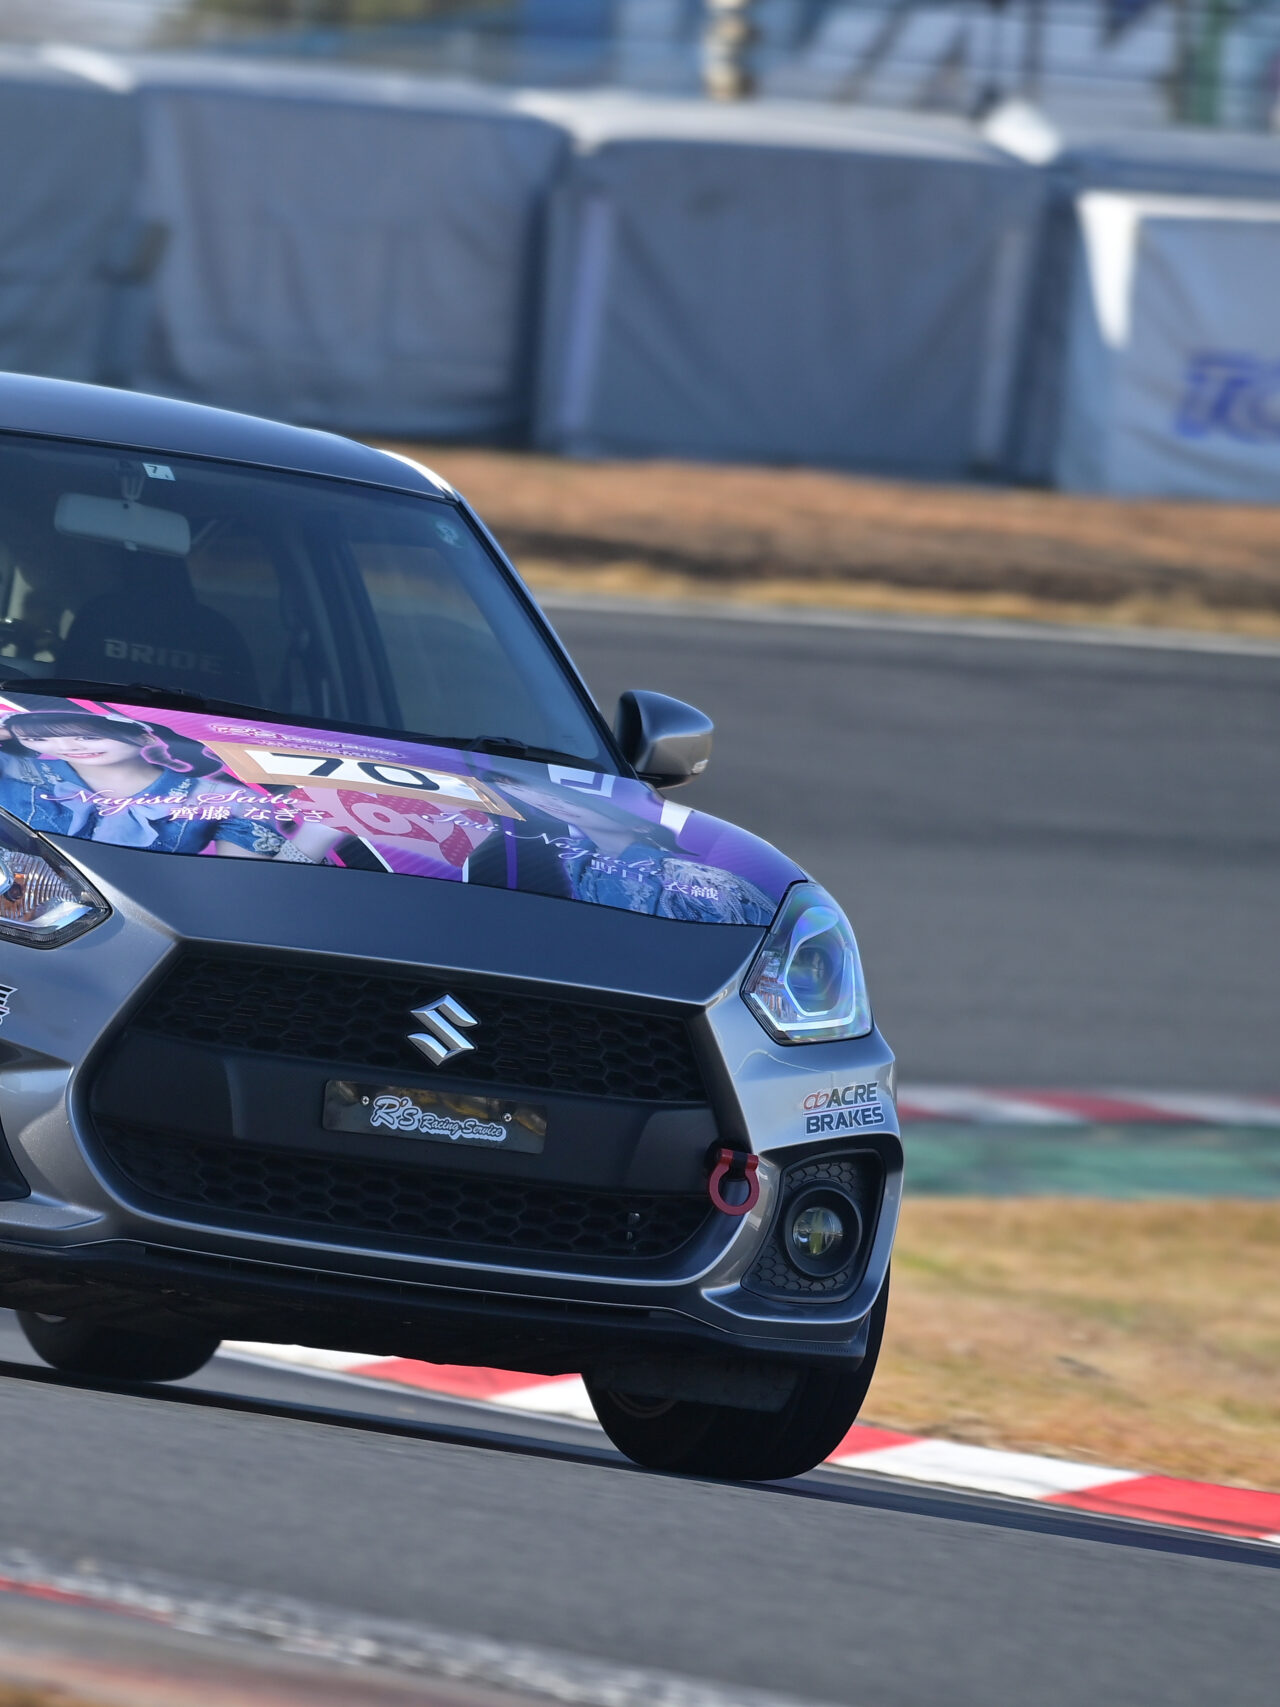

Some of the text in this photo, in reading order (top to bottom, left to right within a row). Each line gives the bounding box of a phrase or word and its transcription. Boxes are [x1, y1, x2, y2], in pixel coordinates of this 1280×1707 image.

[269, 752, 440, 791] 70
[40, 789, 300, 817] Nagisa Saito
[826, 1082, 878, 1108] ACRE
[420, 1113, 460, 1138] Racing
[462, 1119, 505, 1139] Service
[806, 1106, 884, 1134] BRAKES
